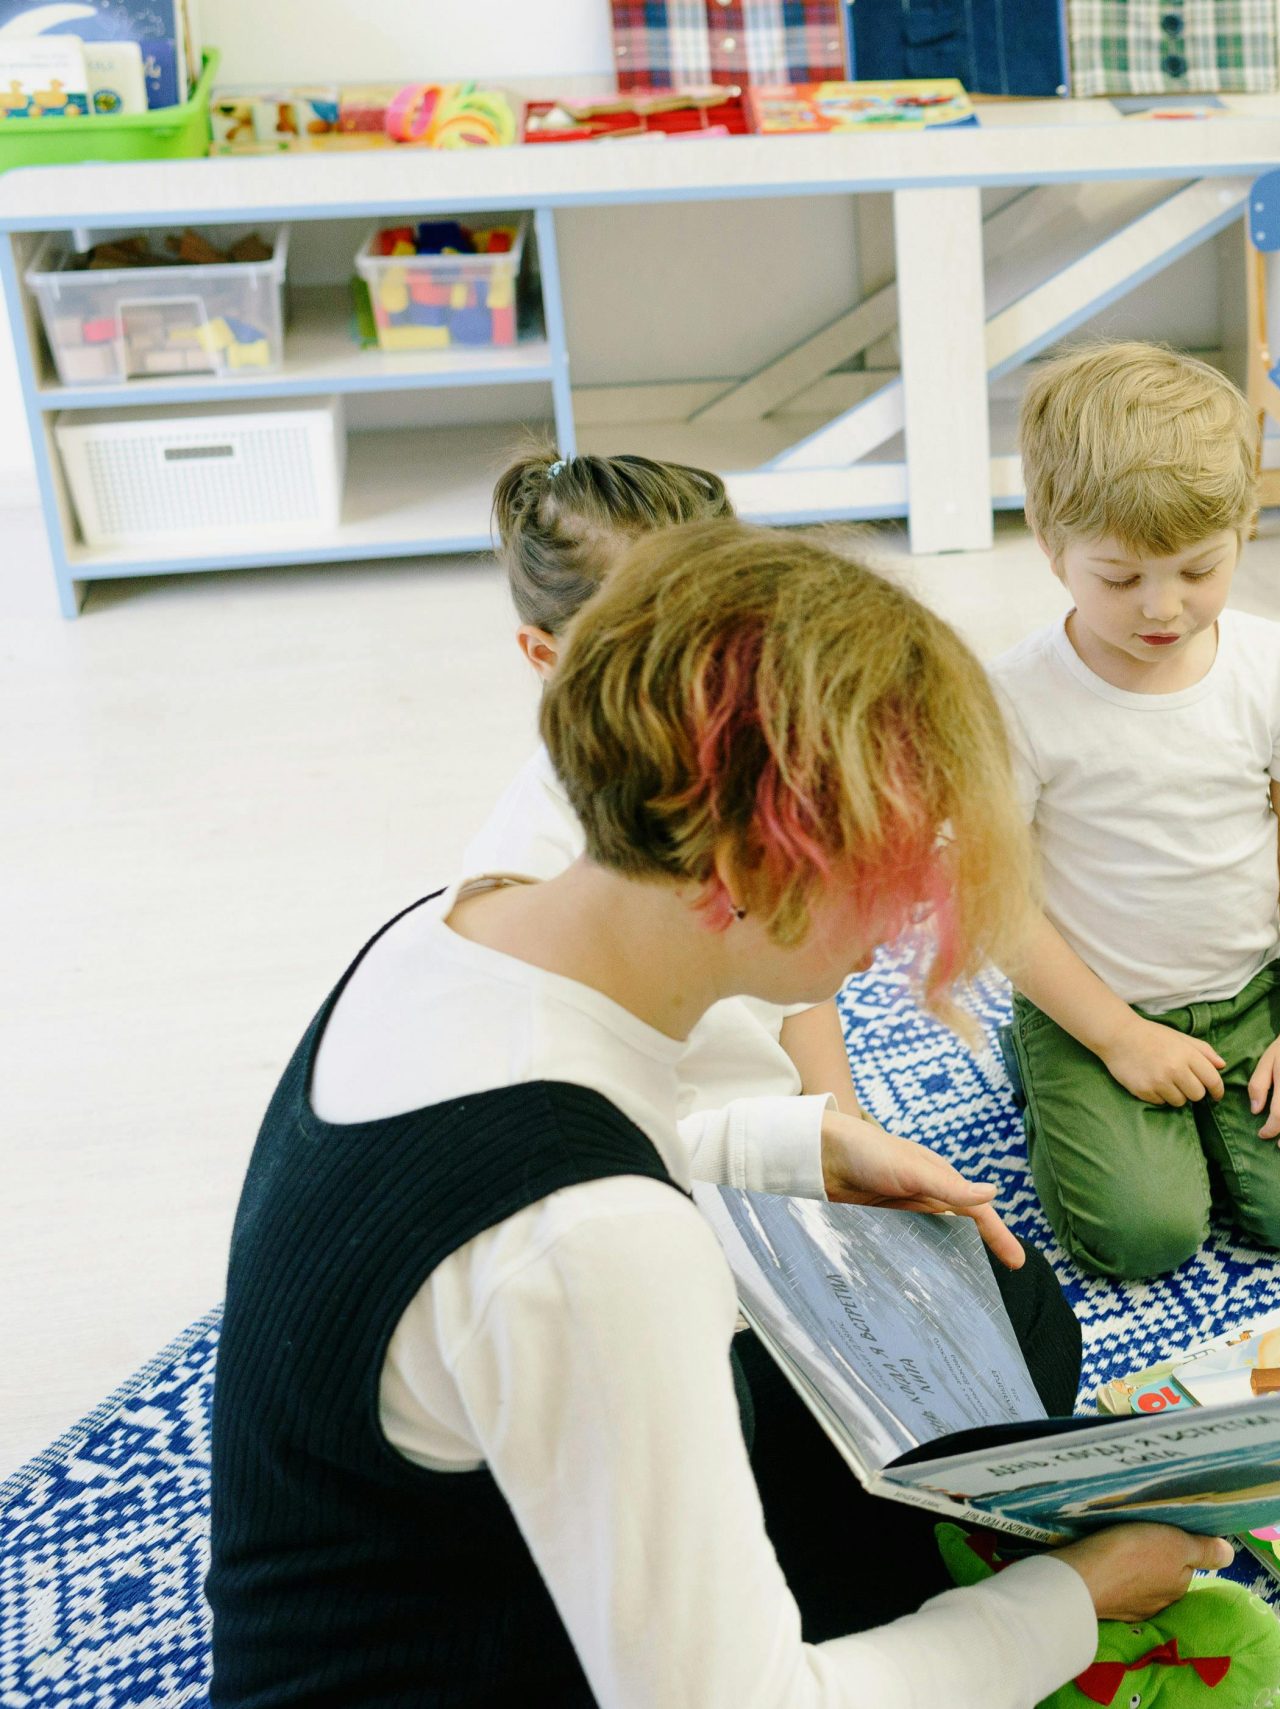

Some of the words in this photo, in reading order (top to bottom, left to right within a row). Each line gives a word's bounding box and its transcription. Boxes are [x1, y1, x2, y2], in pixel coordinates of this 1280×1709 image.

[826, 1274, 878, 1342] ВСТРЕТИЛ
[868, 1345, 889, 1359] Я
[899, 1357, 935, 1395] КИТА
[1137, 1385, 1182, 1414] 10
[1055, 1443, 1136, 1461] КОГДА
[1134, 1438, 1160, 1447] Я
[1114, 1449, 1188, 1465] КИТА
